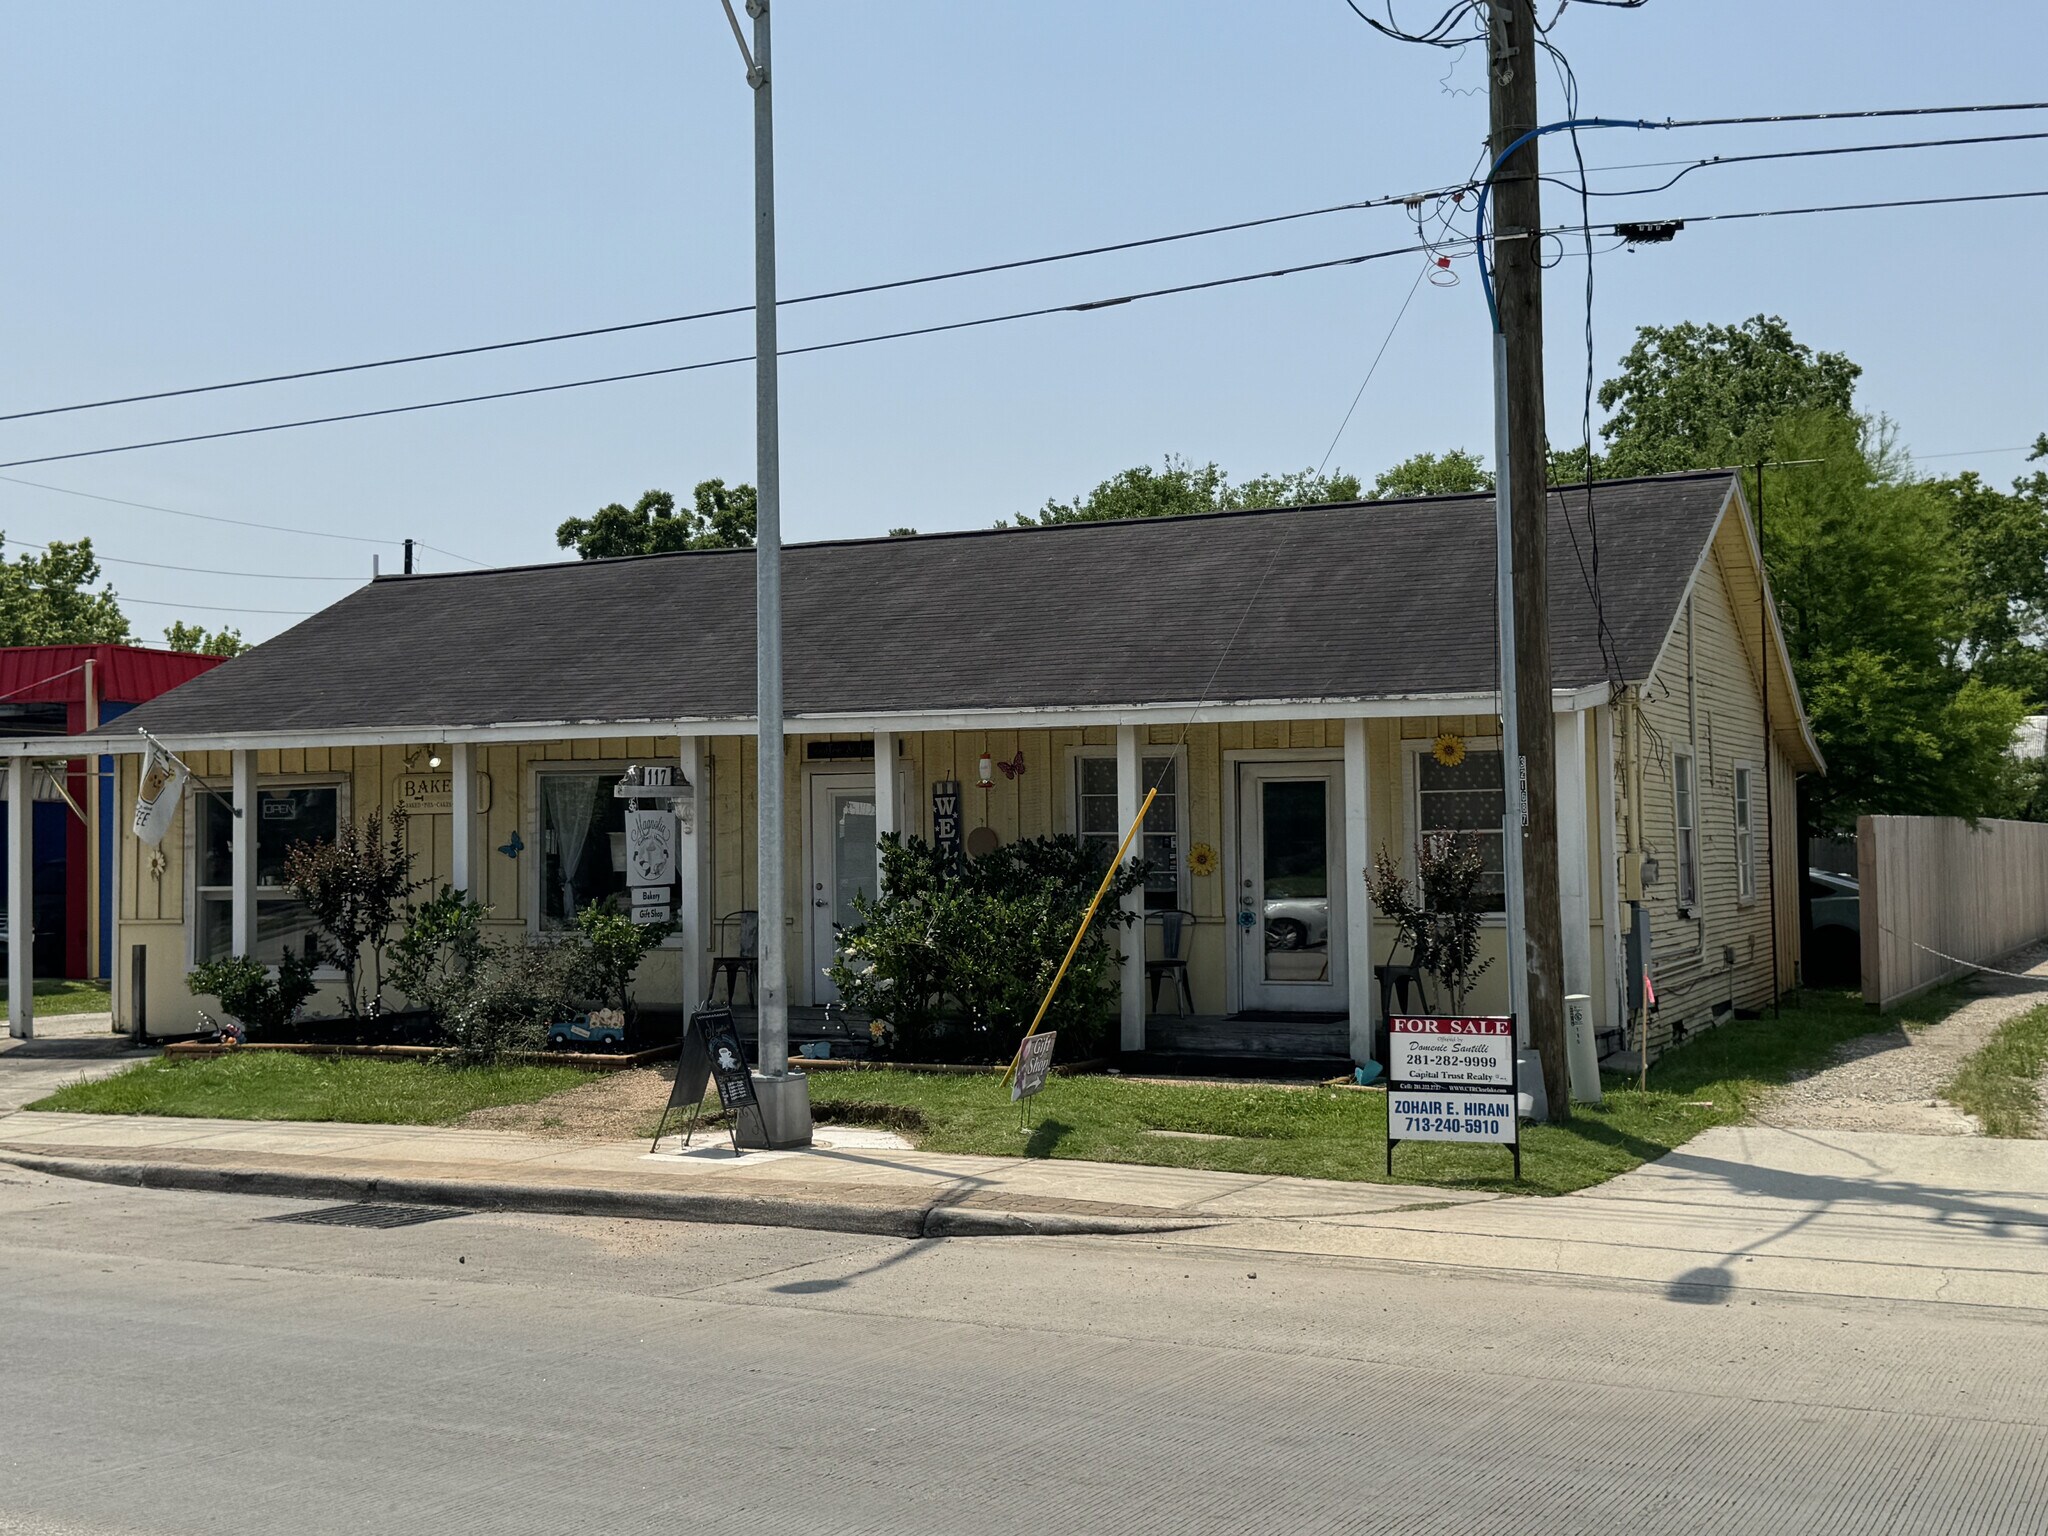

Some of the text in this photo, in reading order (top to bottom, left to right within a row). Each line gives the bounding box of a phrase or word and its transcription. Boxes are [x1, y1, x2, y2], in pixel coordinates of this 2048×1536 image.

[648, 769, 666, 785] 117
[405, 780, 452, 796] BAKE
[265, 803, 295, 815] OPEN
[631, 814, 670, 841] Magnolia
[642, 891, 661, 901] Bakery
[639, 909, 663, 919] Gift Shop
[1394, 1019, 1509, 1035] FOR SALE
[1033, 1035, 1052, 1058] Gift
[1409, 1041, 1489, 1053] Domenic Santilli
[1027, 1056, 1049, 1076] Shop
[1406, 1054, 1497, 1068] 281-282-9999
[1409, 1070, 1439, 1080] Capital
[1441, 1071, 1464, 1080] Trust
[1467, 1072, 1493, 1082] Realty
[1395, 1101, 1509, 1117] ZOHAIR E. HIRANI
[1405, 1117, 1499, 1134] 713-240-5910
